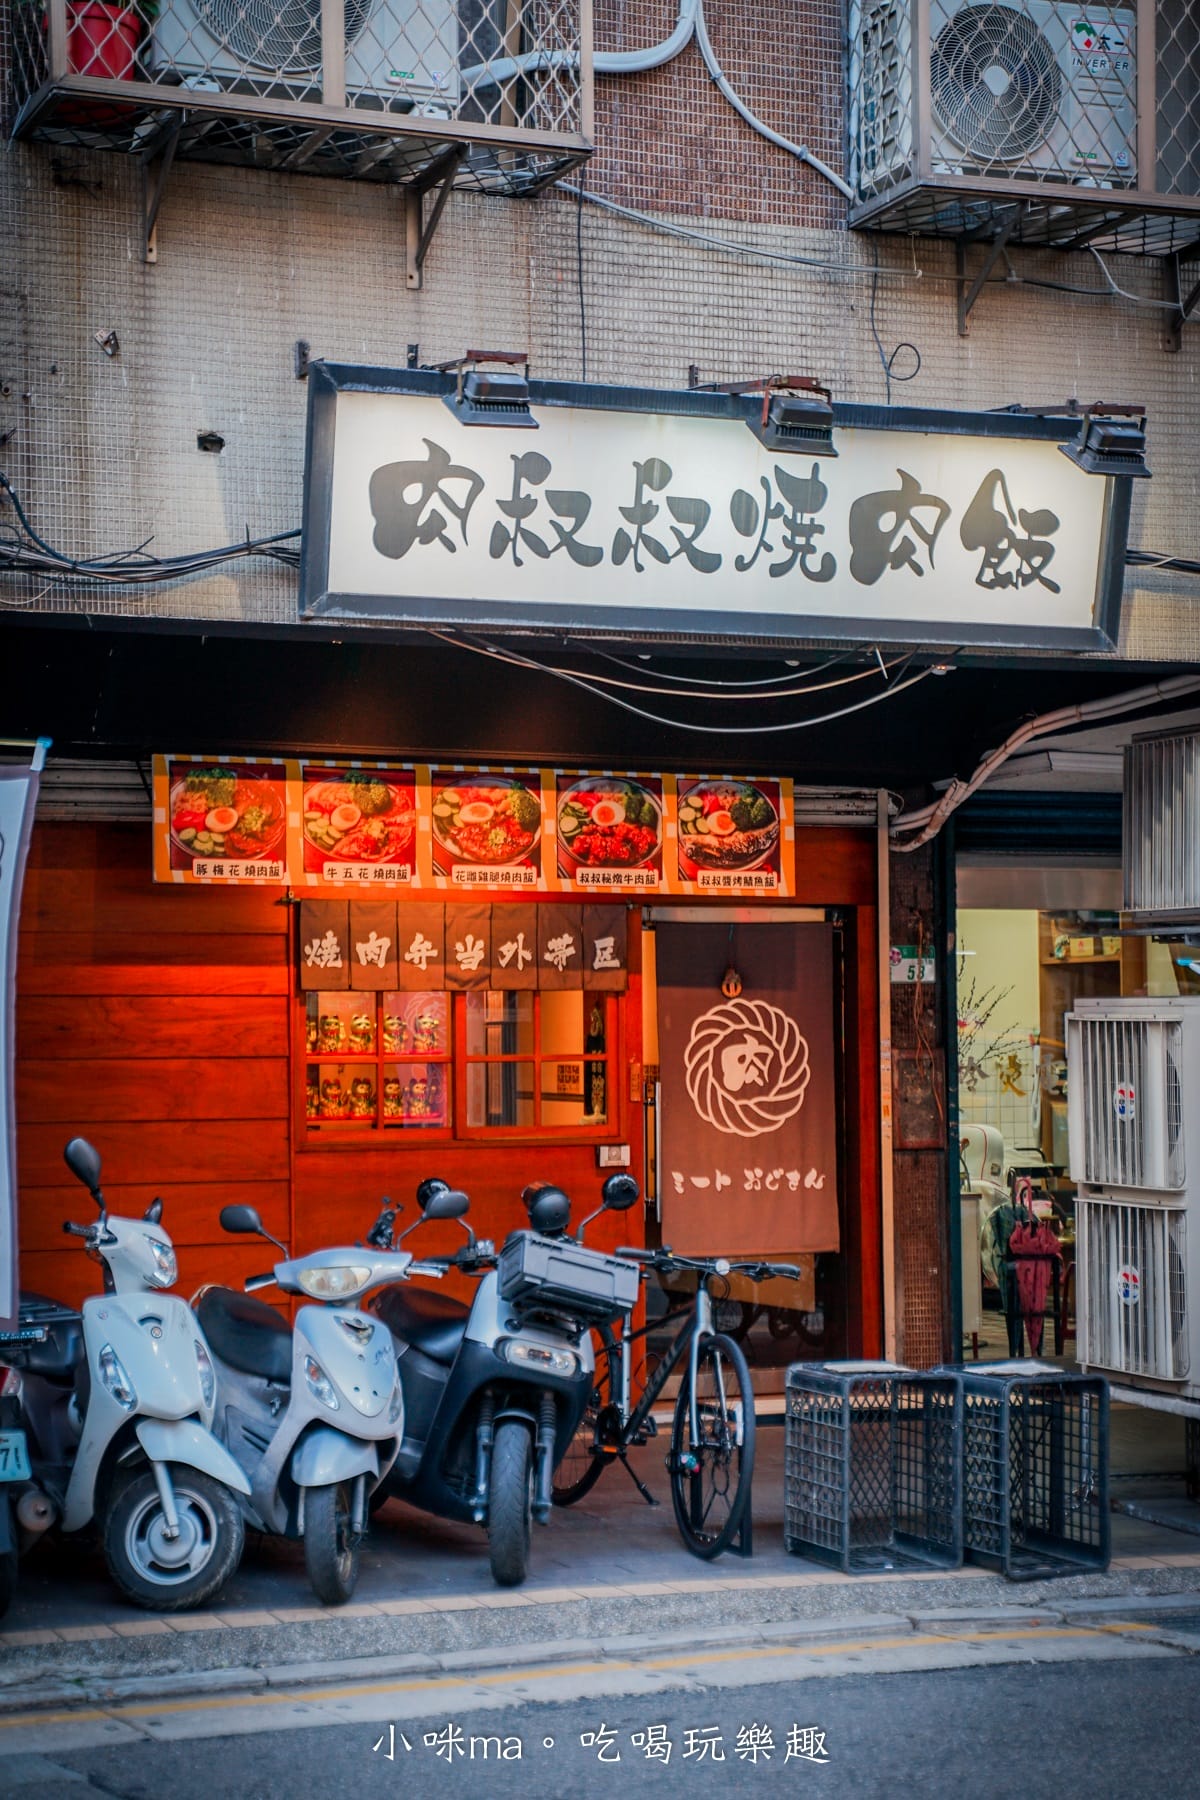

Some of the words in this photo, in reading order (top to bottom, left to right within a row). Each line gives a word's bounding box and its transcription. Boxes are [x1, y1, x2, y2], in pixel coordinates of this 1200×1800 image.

[1072, 57, 1129, 70] INVERER
[671, 1169, 732, 1194] ミート
